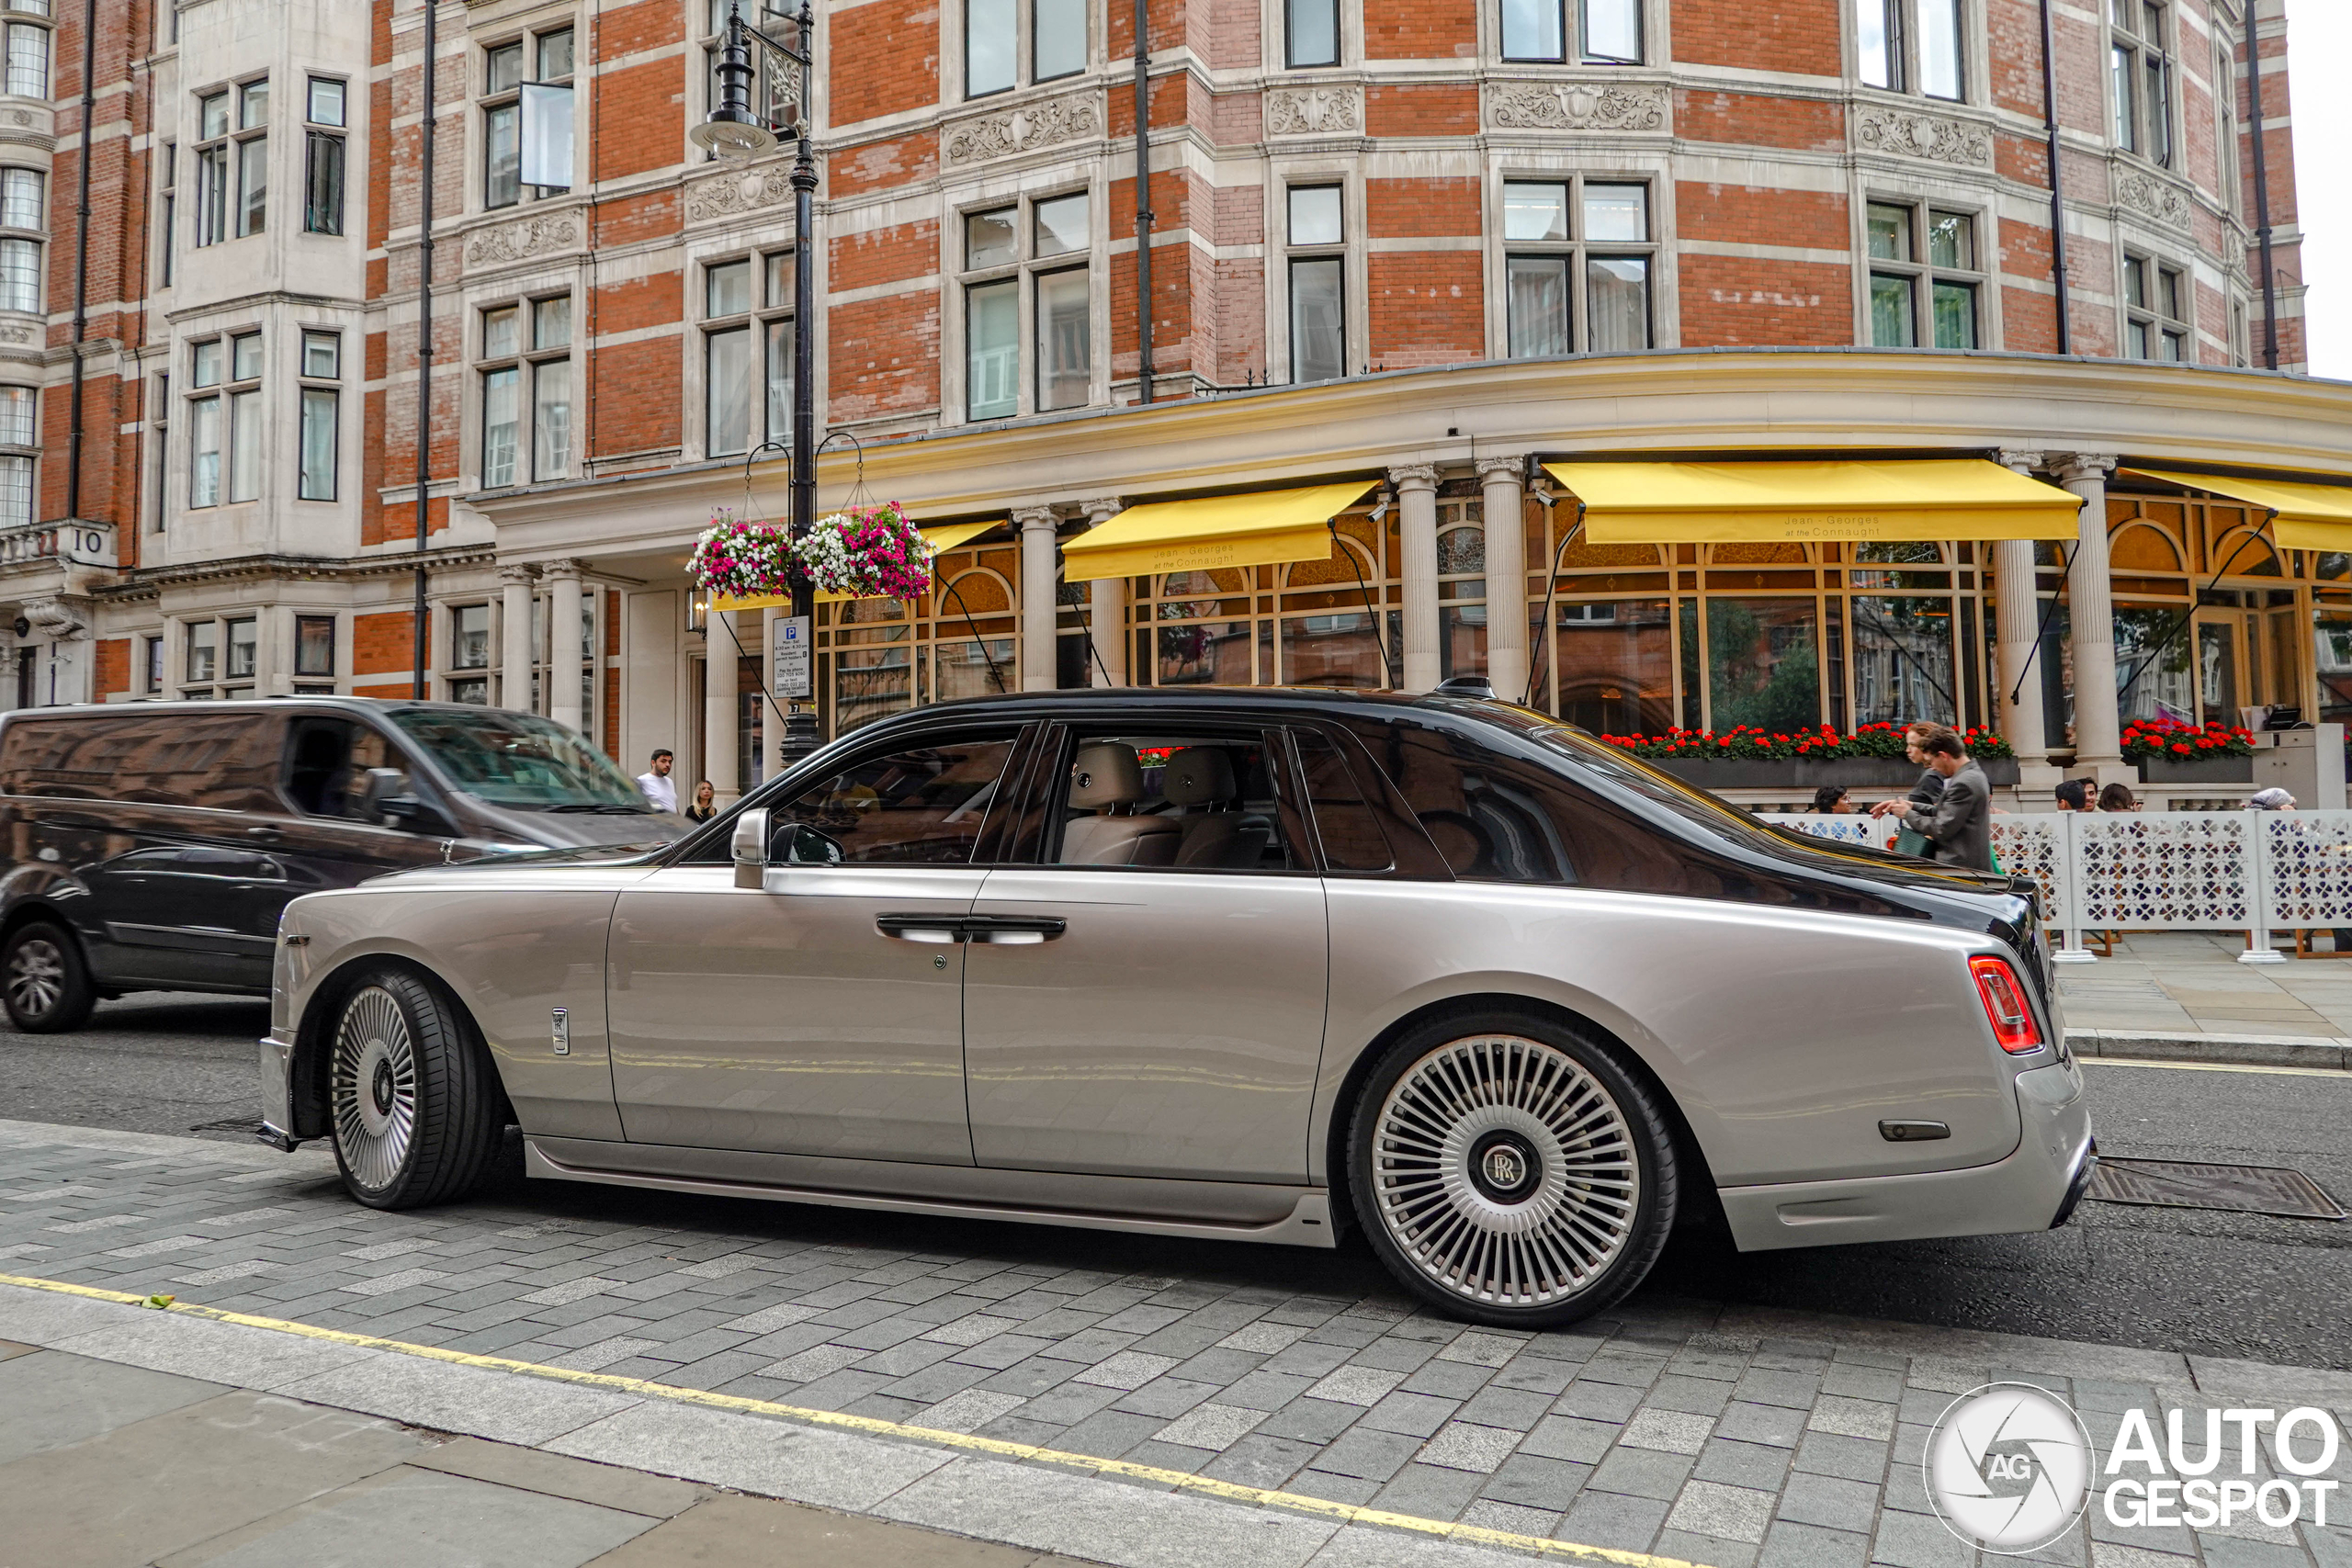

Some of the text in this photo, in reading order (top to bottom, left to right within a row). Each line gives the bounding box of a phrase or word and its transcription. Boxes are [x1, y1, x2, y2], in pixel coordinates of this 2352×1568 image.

[1784, 516, 1814, 525] Jean
[1826, 515, 1880, 526] Georges
[1812, 527, 1881, 537] Connaught
[74, 529, 101, 553] 10
[1153, 549, 1179, 558] Jean
[1189, 544, 1234, 556] Georges
[1176, 555, 1234, 567] Connaught
[787, 628, 796, 638] P
